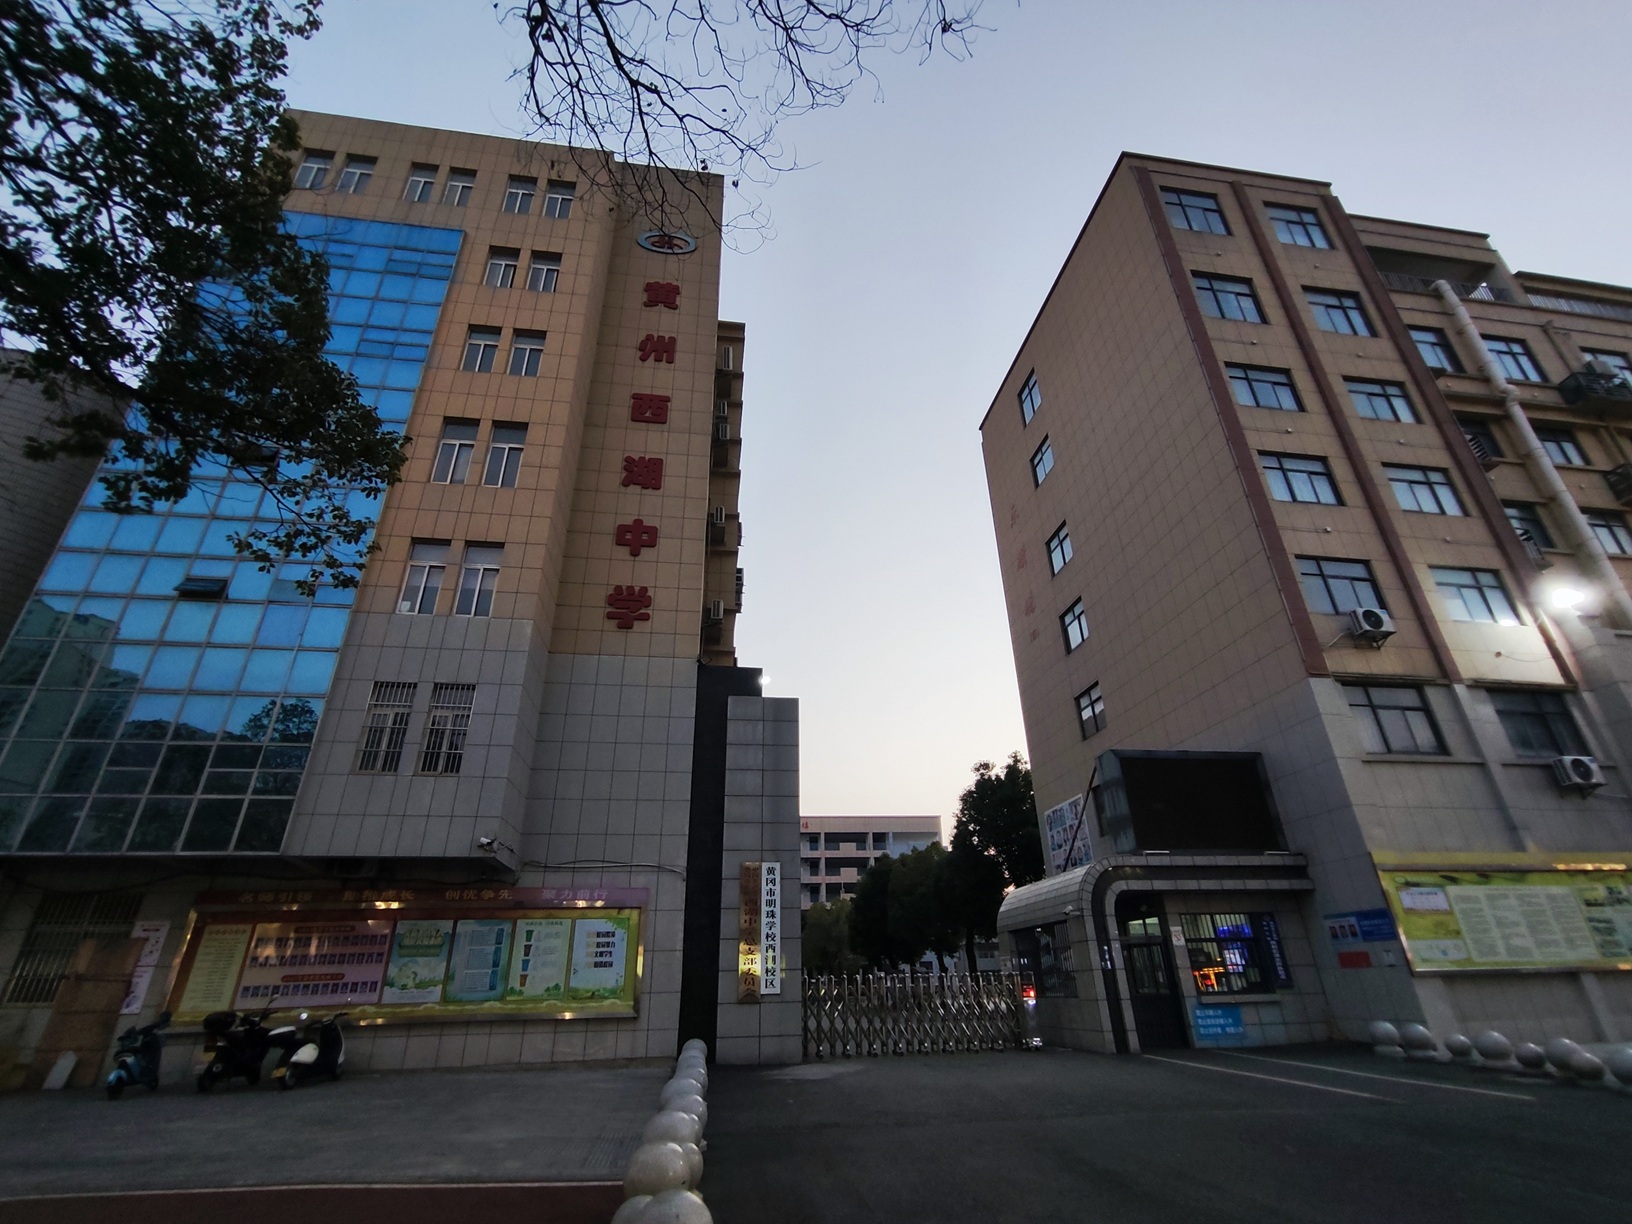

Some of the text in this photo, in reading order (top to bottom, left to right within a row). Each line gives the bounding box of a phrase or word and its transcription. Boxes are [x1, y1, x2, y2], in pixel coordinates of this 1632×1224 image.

[606, 281, 681, 630] 黄州西湖中学
[445, 889, 513, 900] 创优争先
[541, 888, 609, 900] 聚力前行
